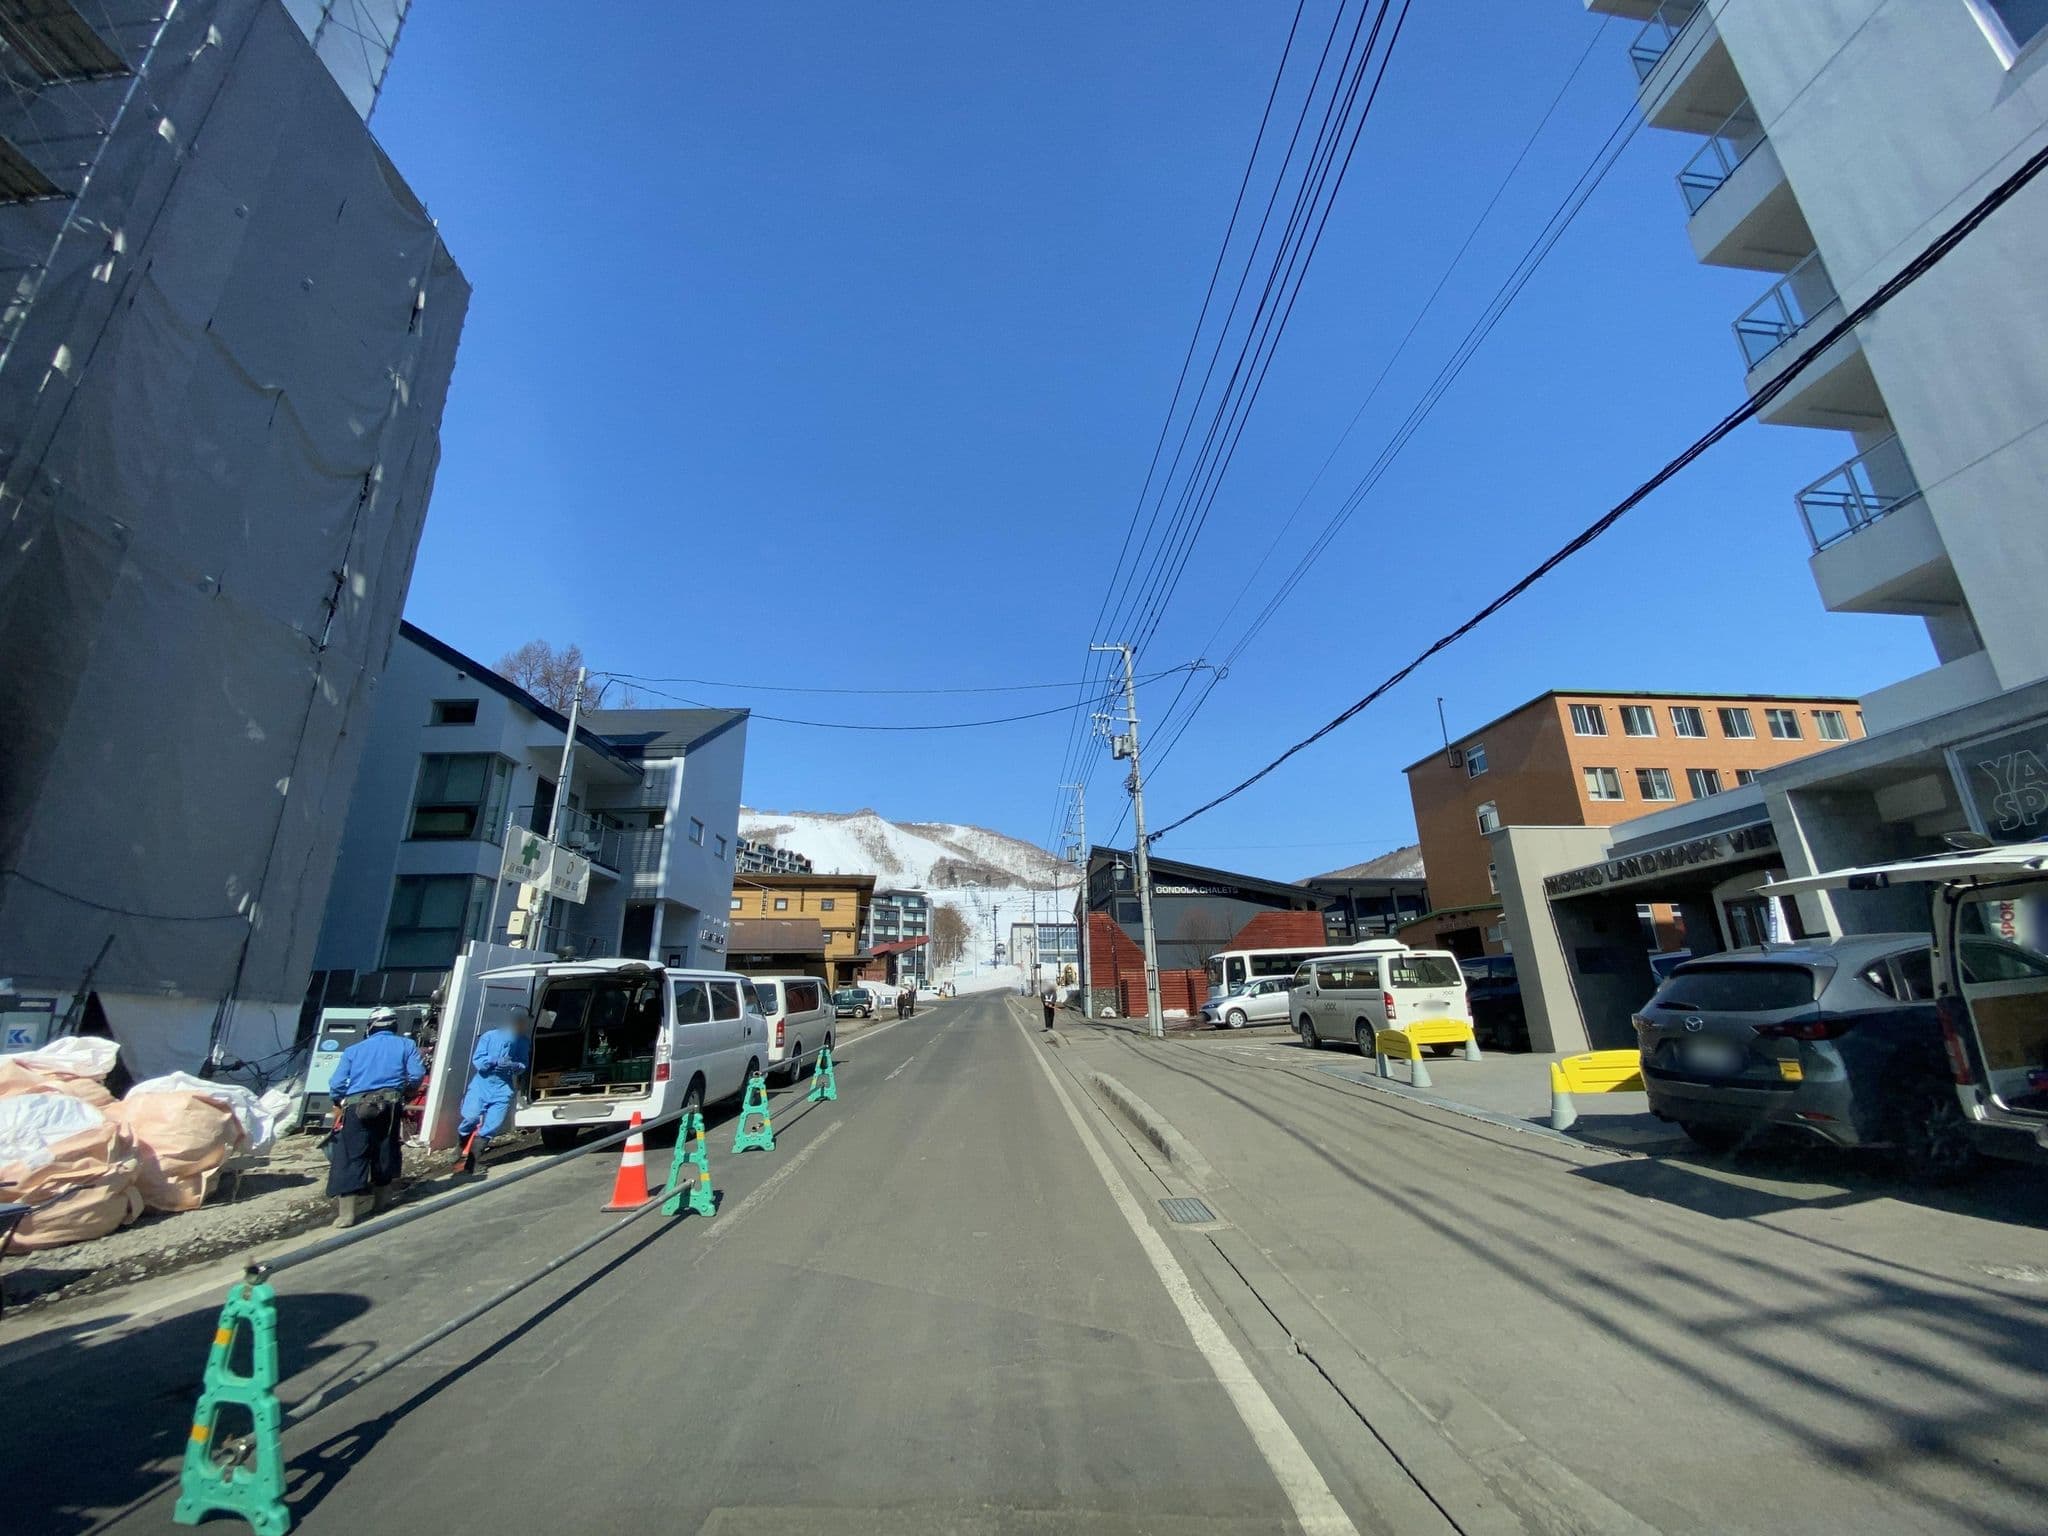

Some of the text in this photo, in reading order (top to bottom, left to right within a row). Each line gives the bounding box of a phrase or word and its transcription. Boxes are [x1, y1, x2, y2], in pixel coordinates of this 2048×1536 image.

[1545, 868, 1603, 895] NISEKO
[1607, 839, 1723, 881] LANDMARK
[1155, 886, 1239, 894] GONDOLA CHALETS
